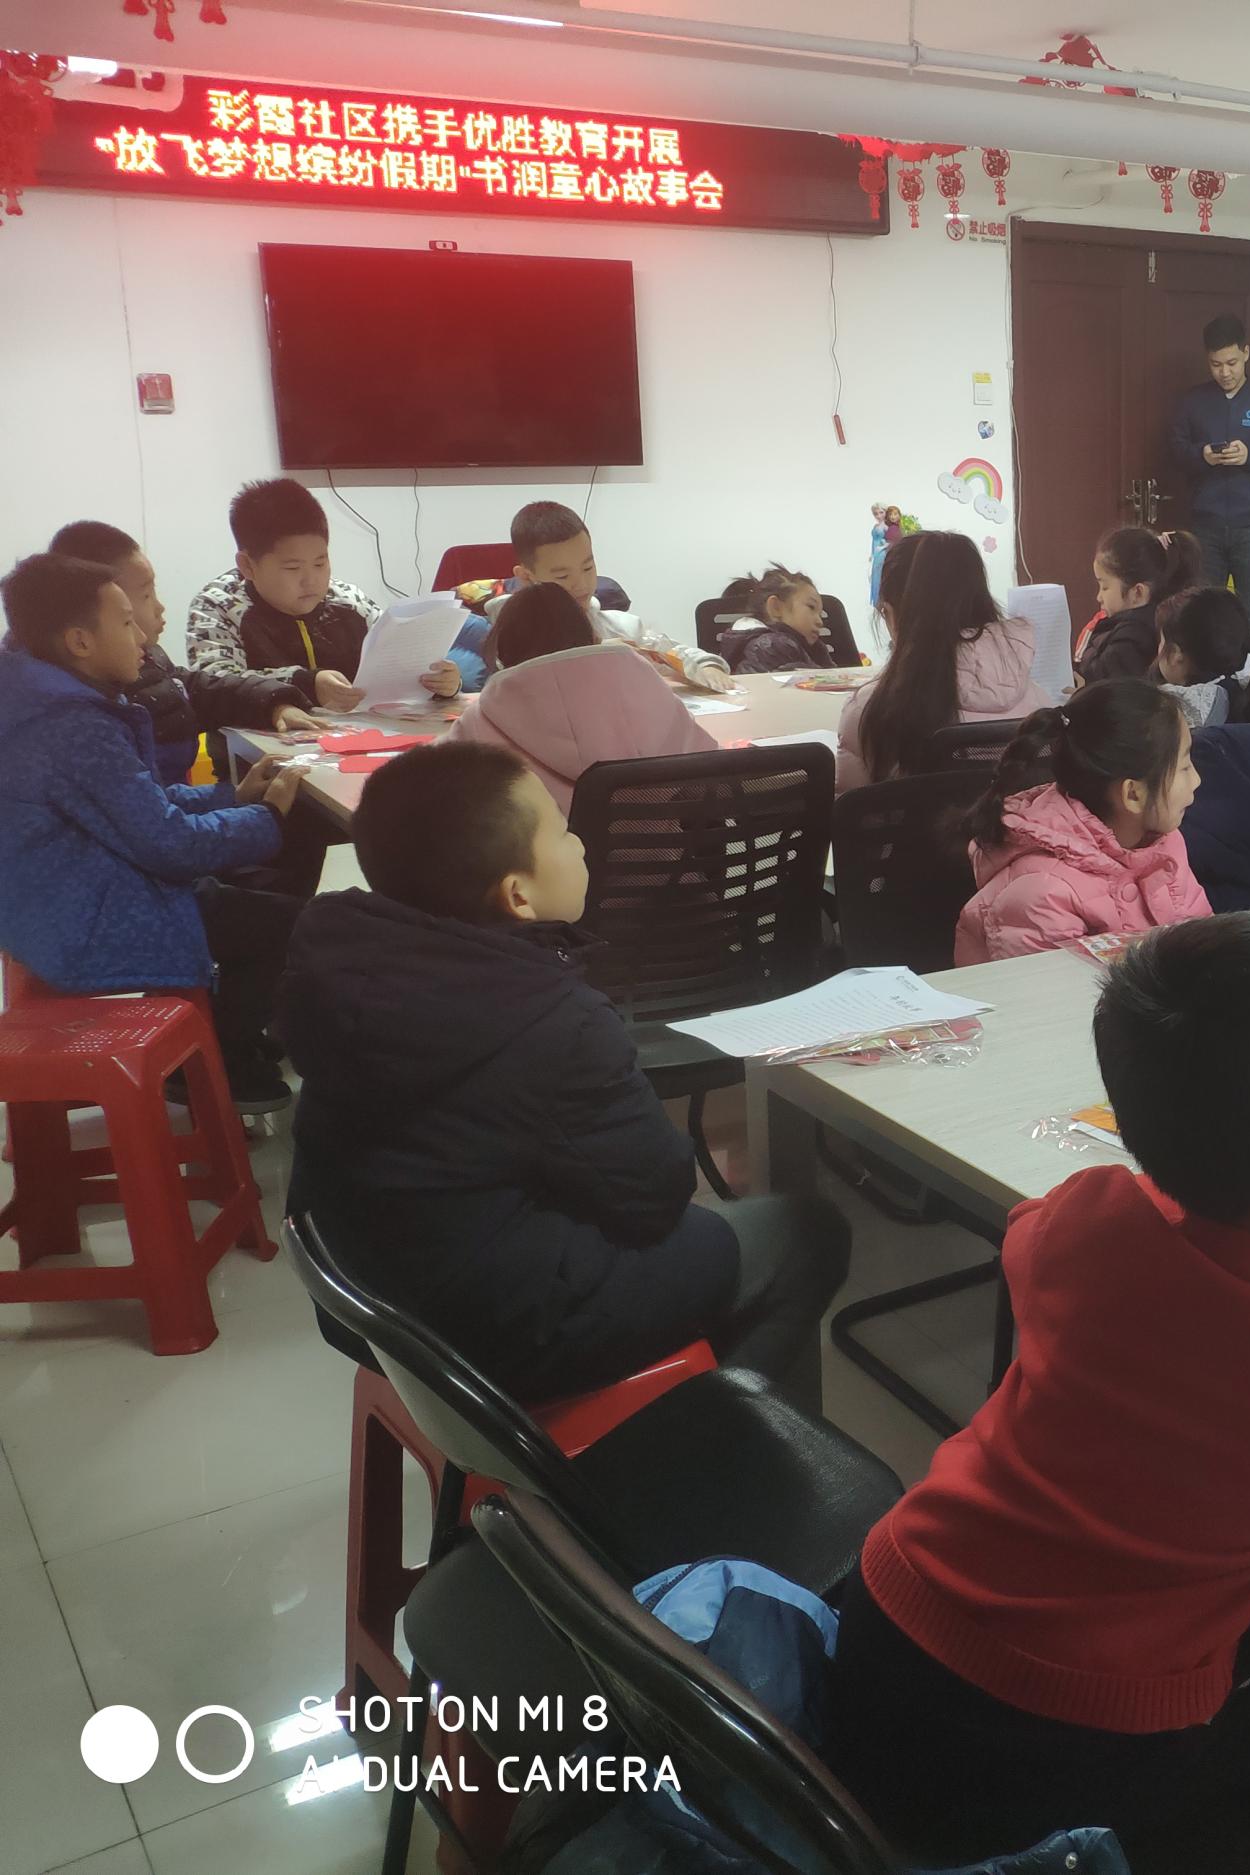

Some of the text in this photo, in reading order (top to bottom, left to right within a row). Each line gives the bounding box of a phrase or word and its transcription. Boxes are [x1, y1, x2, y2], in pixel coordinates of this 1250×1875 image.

[208, 89, 682, 165] 彩霞社区携手优胜教育开展
[968, 220, 1007, 238] 禁止吸烟
